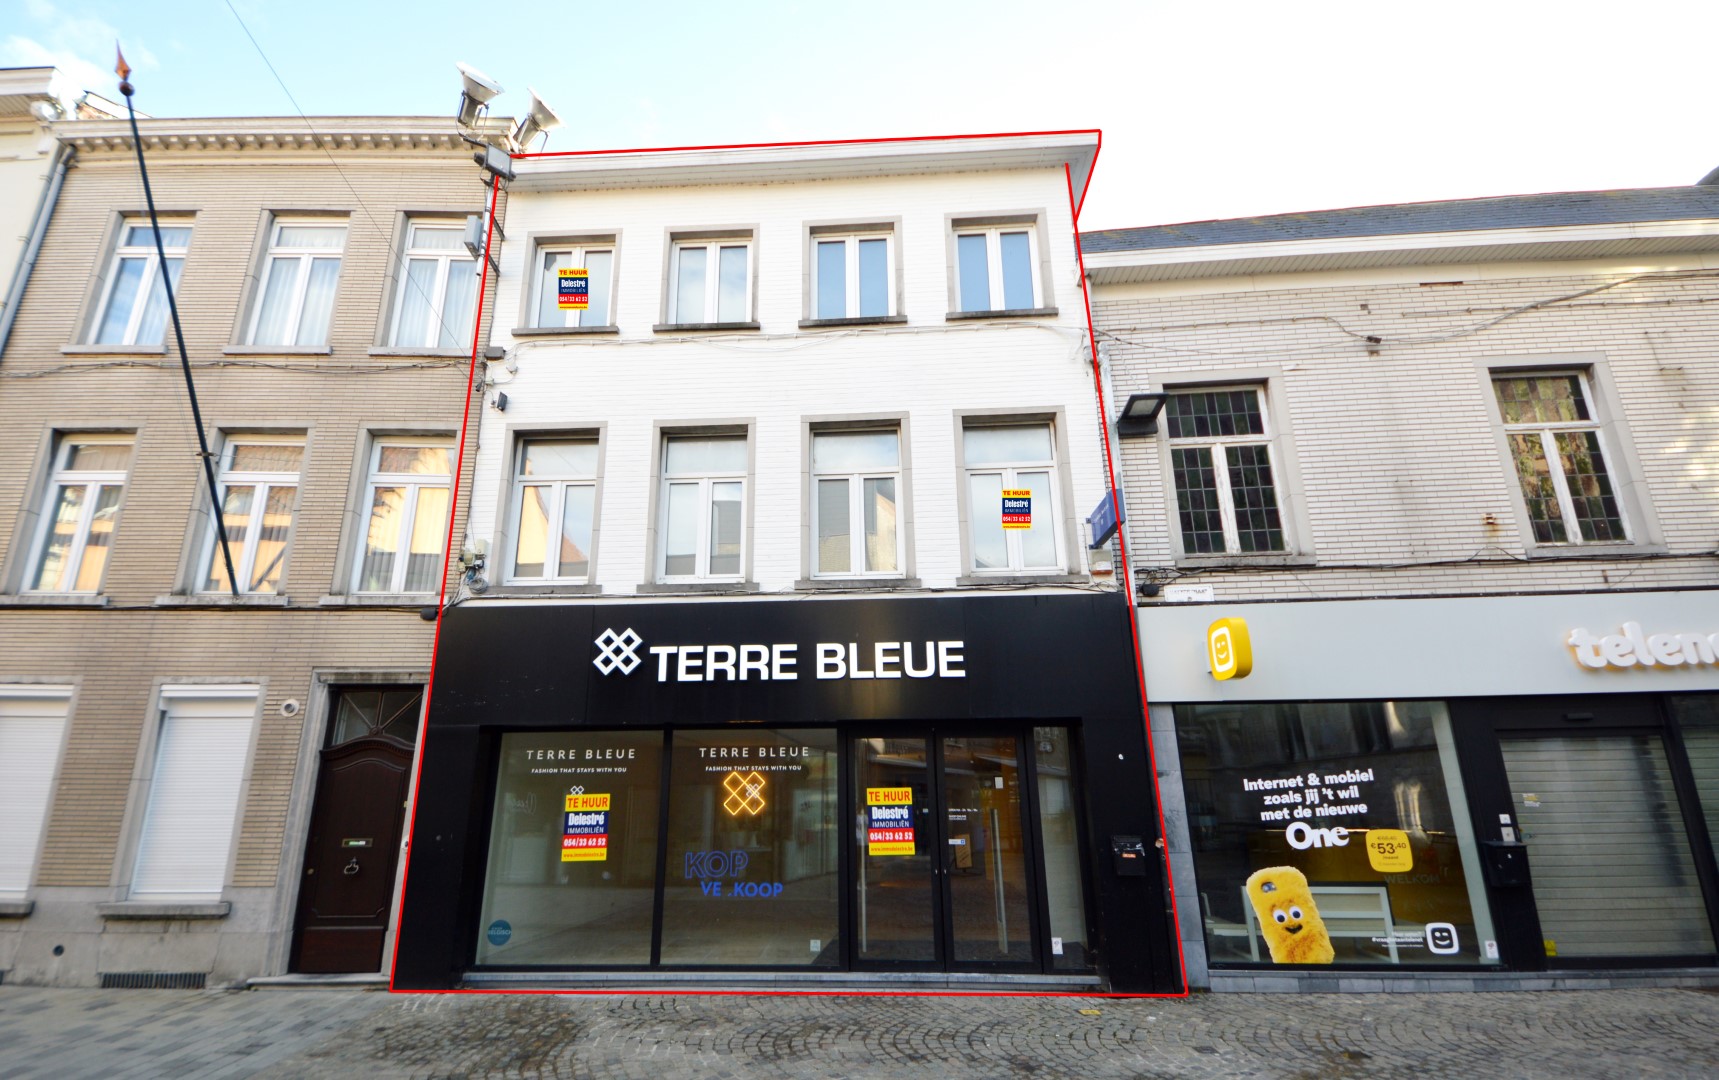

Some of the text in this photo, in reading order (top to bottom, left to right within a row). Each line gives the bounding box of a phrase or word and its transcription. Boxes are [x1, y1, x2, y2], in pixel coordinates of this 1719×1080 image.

[561, 279, 586, 288] Delestré
[1004, 499, 1028, 508] Delestré
[649, 640, 967, 682] TERRE BLEUE
[527, 748, 636, 760] TERRE BLEUE
[699, 746, 809, 758] TERRE BLEUE
[1243, 768, 1375, 791] Internet & mobiel
[868, 790, 911, 802] TE HUUR
[1263, 791, 1303, 805] zoals
[1304, 788, 1320, 805] jij
[1337, 785, 1360, 799] wil
[568, 797, 608, 808] TE HUUR
[872, 806, 908, 820] Delestré
[1260, 803, 1368, 821] met de nieuwe
[568, 812, 605, 826] Delestré
[870, 832, 913, 841] 054/33 62 52
[1285, 821, 1350, 850] One
[564, 838, 606, 848] 054/33 62 52
[685, 850, 749, 879] KOP
[1384, 874, 1441, 884] WELKOM
